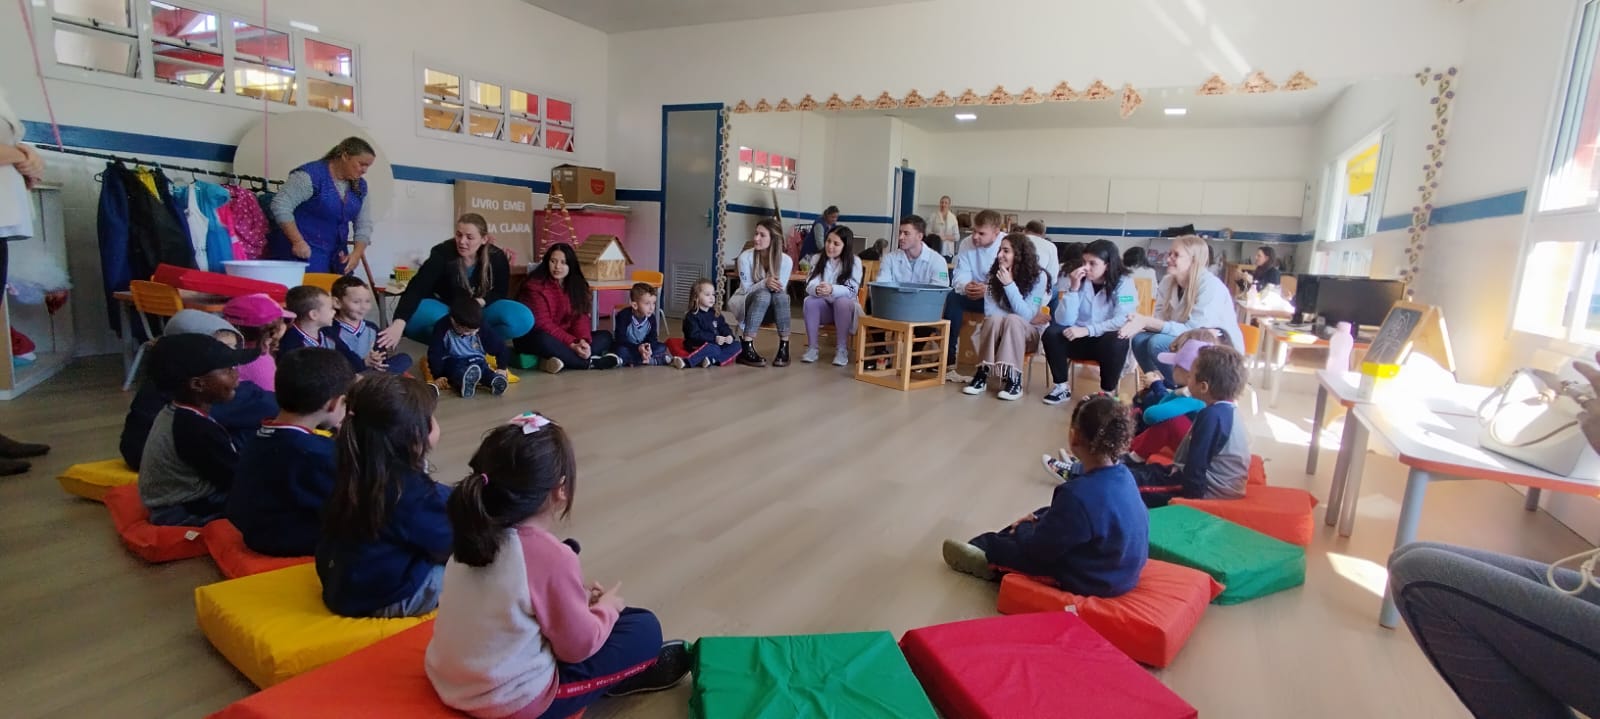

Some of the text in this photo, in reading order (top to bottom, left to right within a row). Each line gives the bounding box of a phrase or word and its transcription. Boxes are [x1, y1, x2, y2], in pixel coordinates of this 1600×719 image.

[471, 196, 526, 211] LIVRO EMEI
[500, 223, 530, 233] CLARA
